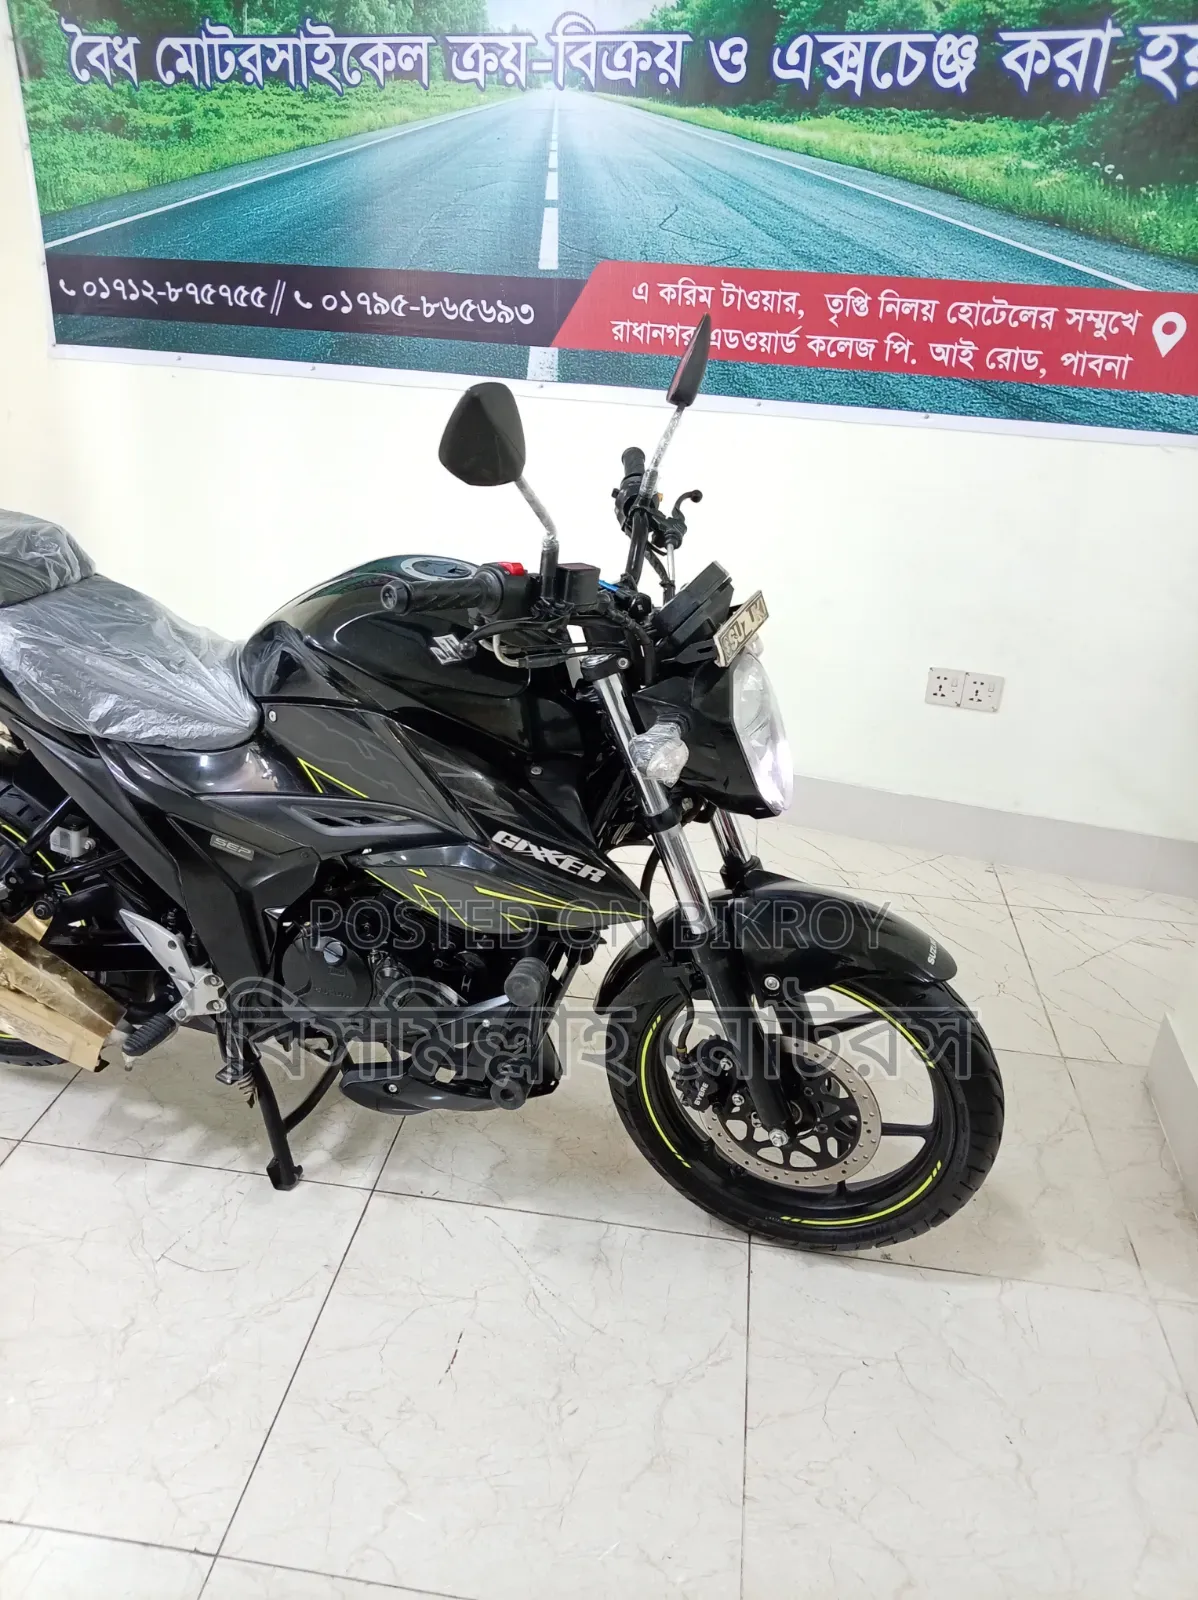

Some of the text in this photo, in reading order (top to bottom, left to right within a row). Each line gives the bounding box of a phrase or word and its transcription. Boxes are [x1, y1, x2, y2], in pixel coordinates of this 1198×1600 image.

[62, 18, 140, 89] বৈধ
[156, 19, 436, 95] মোটরসাইকেল
[709, 36, 748, 84] ও
[772, 33, 978, 97] এক্সচেঞ্জ
[999, 18, 1124, 93] করা
[321, 290, 535, 325] ০১৭৯৫-৮৬৫৬৯৩
[632, 277, 1143, 341] এ করিম টাওয়ার, তৃপ্তি নিলয় হোটেলের সম্মুখে
[610, 319, 697, 348] রাধানগর
[709, 325, 803, 355] এডওয়ার্ড
[805, 334, 879, 361] কলেজ
[928, 337, 979, 371] আই
[985, 345, 1047, 379] রোড,
[1060, 350, 1134, 381] পাবনা
[213, 837, 251, 854] SEP
[491, 830, 607, 883] GIXXER
